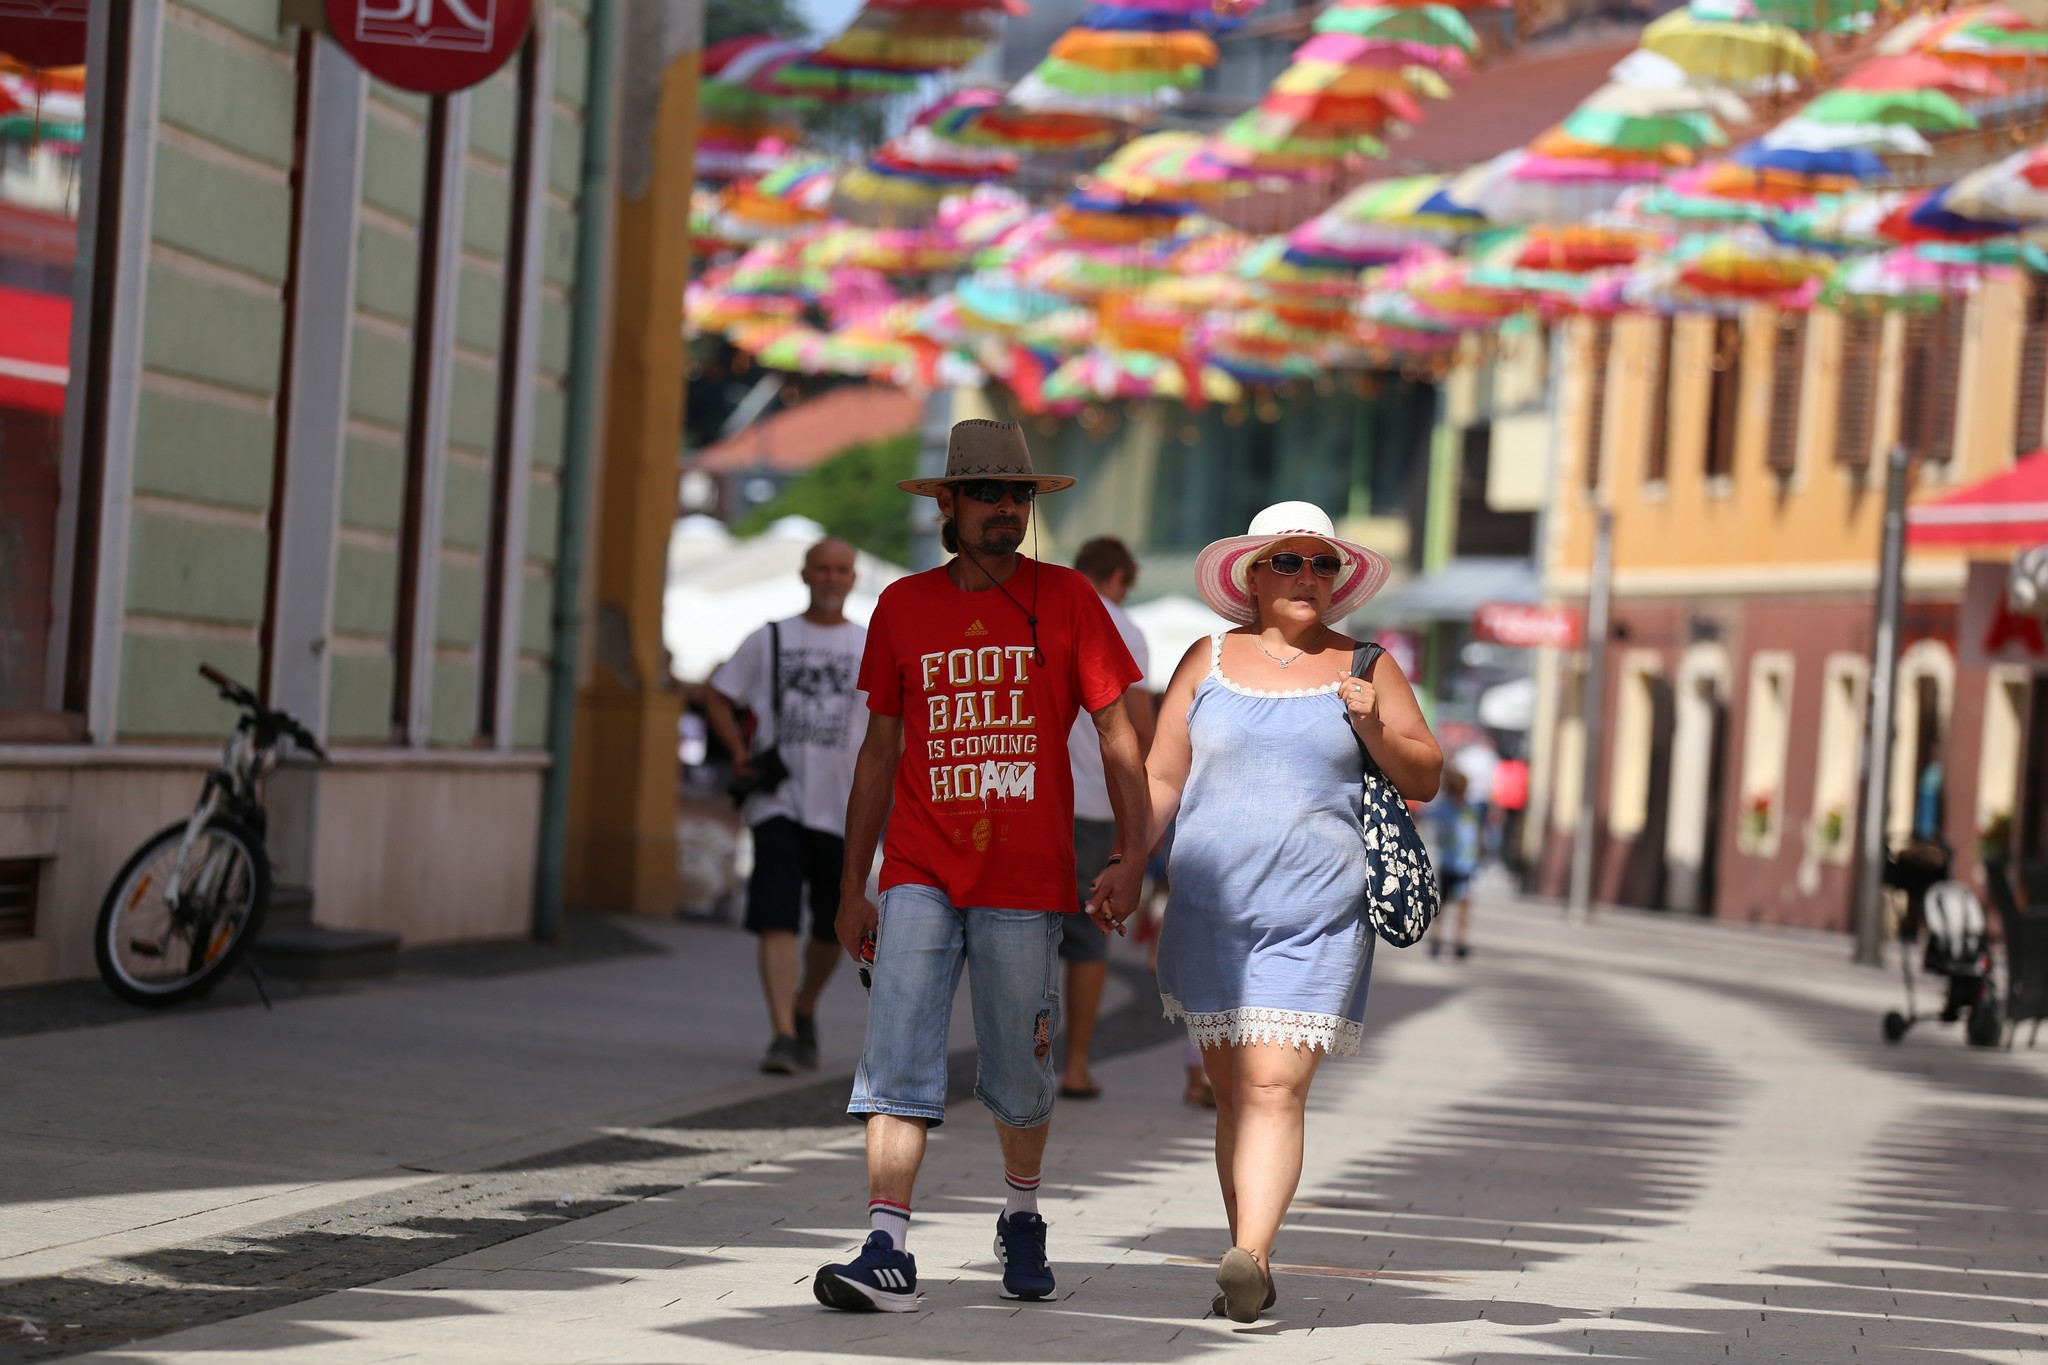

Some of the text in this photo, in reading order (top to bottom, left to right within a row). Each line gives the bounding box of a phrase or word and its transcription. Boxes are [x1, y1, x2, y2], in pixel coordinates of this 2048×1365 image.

[964, 629, 989, 637] adidas
[920, 645, 1037, 692] FOOT
[927, 690, 1036, 734] BALL
[927, 734, 1038, 760] IS COMING
